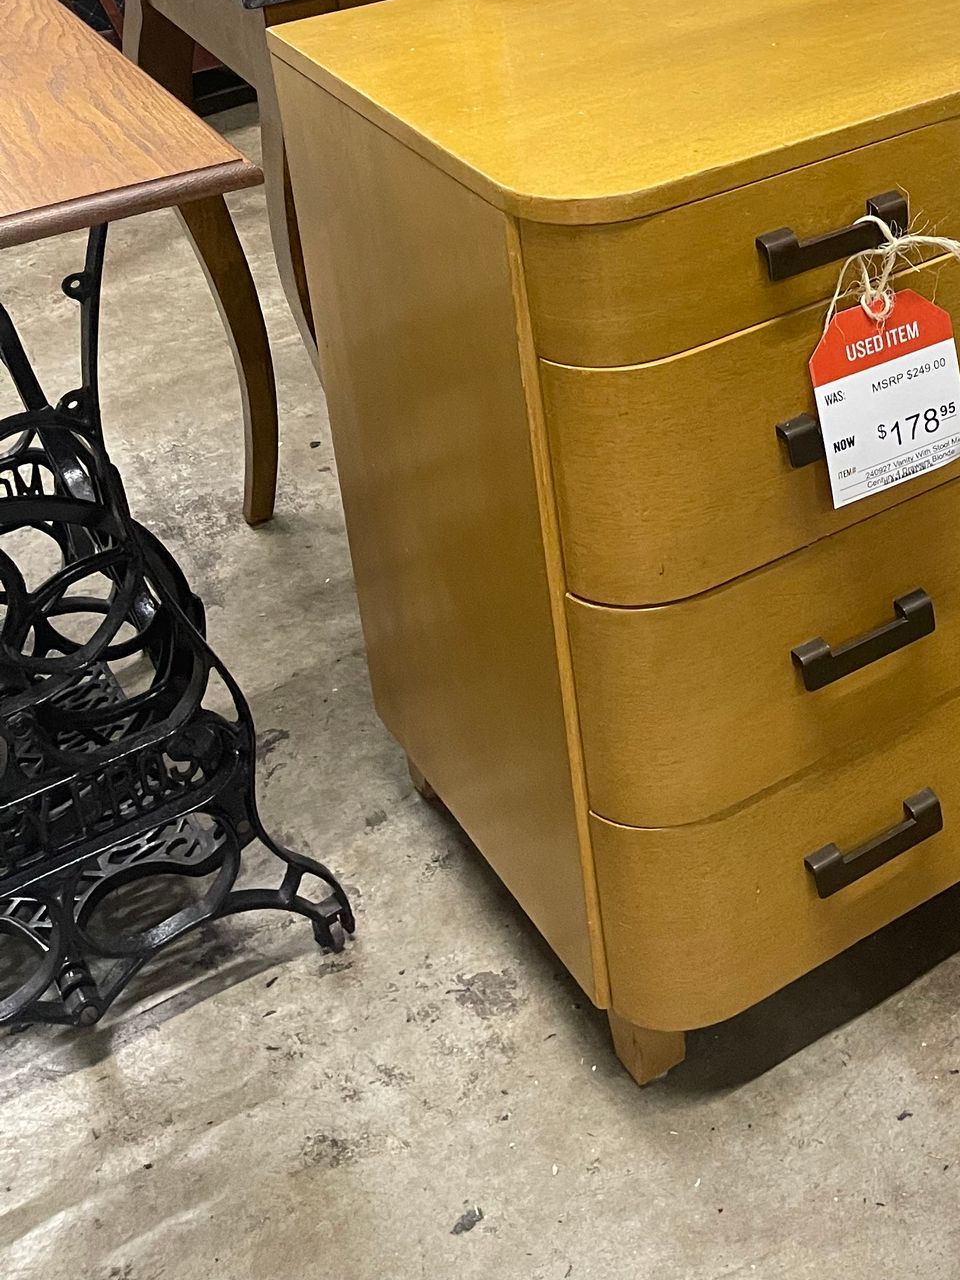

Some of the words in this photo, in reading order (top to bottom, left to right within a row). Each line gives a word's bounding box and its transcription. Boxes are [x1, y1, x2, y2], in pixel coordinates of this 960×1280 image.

[845, 334, 884, 362] USED
[886, 320, 920, 348] ITEM
[824, 390, 846, 406] WAS:
[871, 373, 904, 393] MSRP
[906, 357, 946, 380] $249.00
[833, 435, 856, 453] NOW
[915, 448, 931, 460] With
[932, 441, 951, 452] Stool
[932, 449, 956, 463] Blonde
